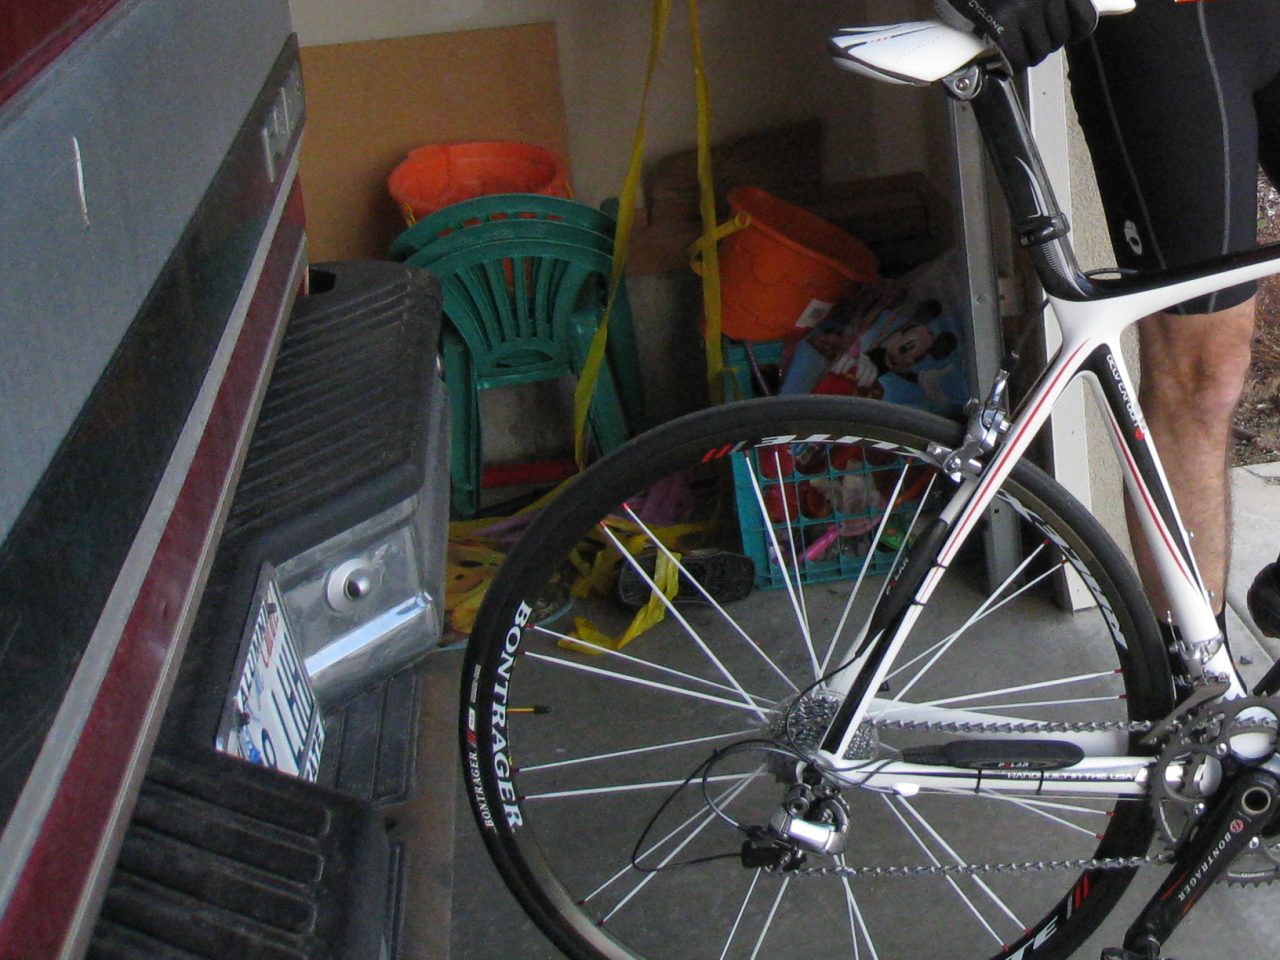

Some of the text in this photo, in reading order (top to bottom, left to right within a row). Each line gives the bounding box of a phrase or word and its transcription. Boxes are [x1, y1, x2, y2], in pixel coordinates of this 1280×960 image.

[968, 0, 1005, 34] CYCLONE
[491, 599, 534, 828] BONTRAGER
[468, 751, 495, 828] BONTRAGER
[1177, 832, 1232, 902] BONTRAGER
